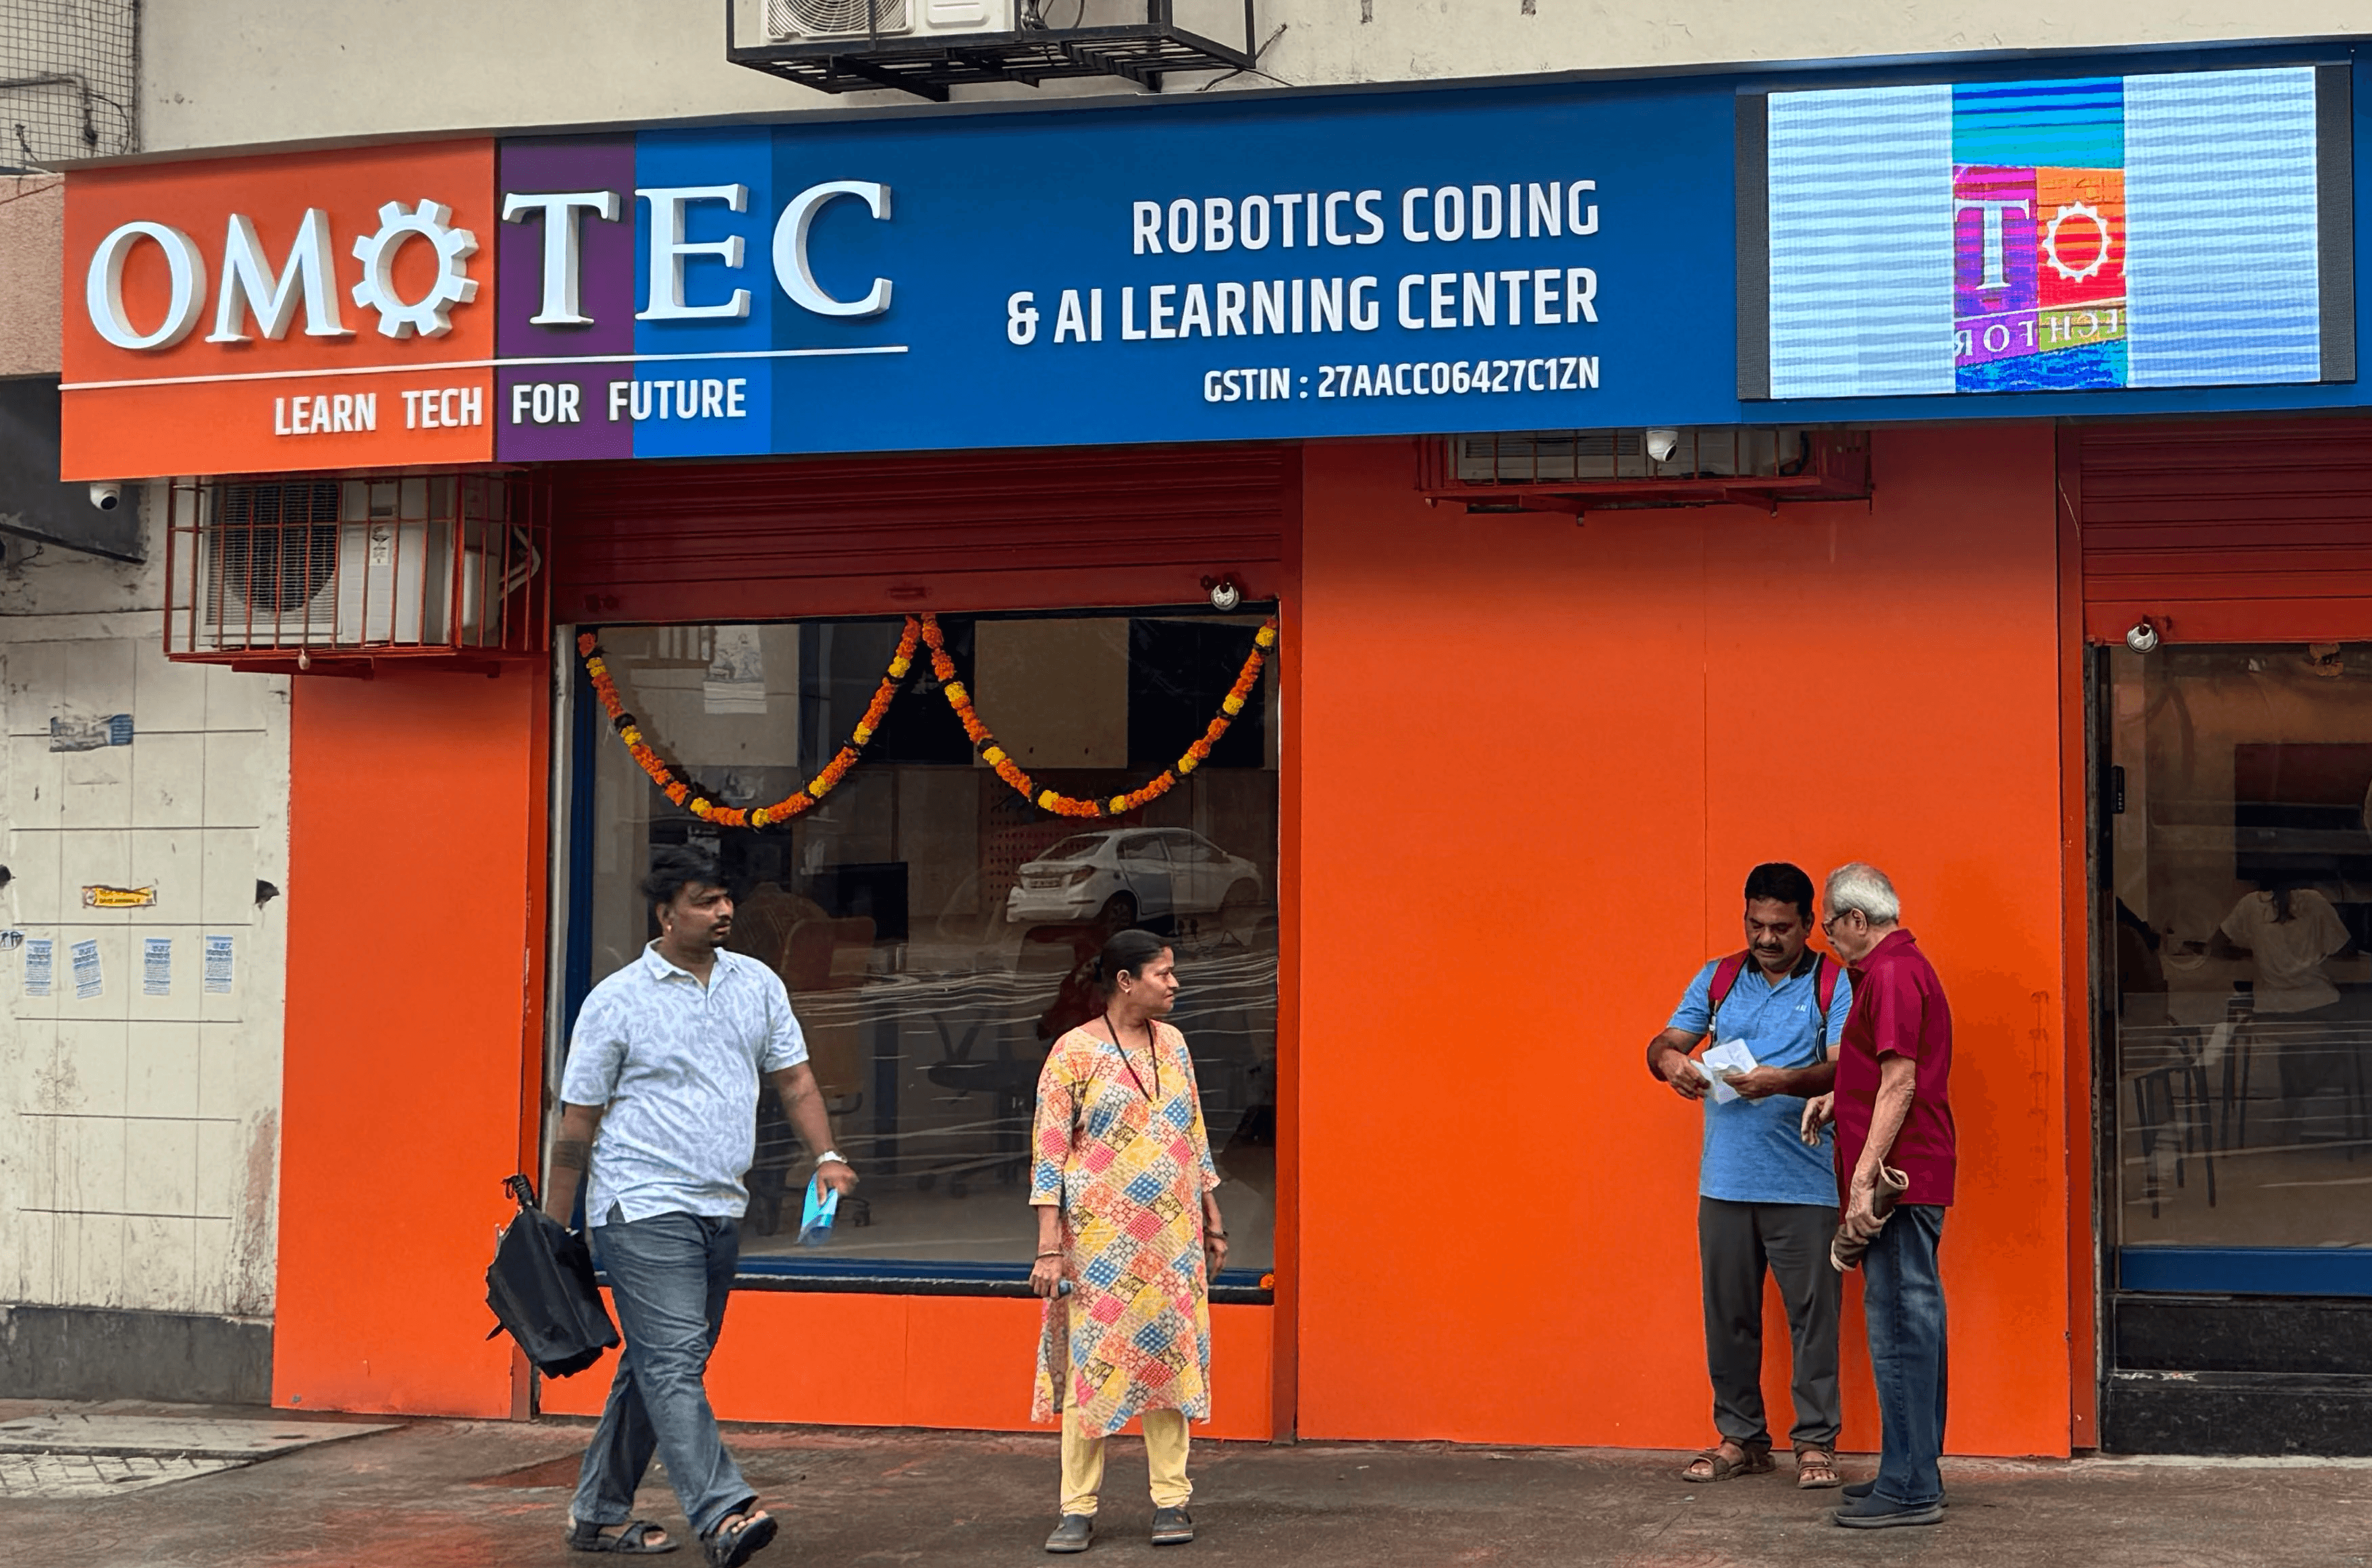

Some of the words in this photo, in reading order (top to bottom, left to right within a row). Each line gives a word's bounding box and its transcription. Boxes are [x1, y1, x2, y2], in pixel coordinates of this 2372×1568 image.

[1133, 190, 1384, 254] ROBOTICS
[1403, 180, 1598, 242] CODING
[1007, 291, 1040, 345] &
[1054, 288, 1102, 343] AI
[1122, 275, 1379, 340] LEARNING
[1398, 267, 1598, 329] CENTER
[275, 392, 377, 435] LEARN
[401, 386, 483, 429] TECH
[512, 383, 581, 424] FOR
[609, 378, 747, 421] FUTURE
[1204, 367, 1290, 402] GSTIN
